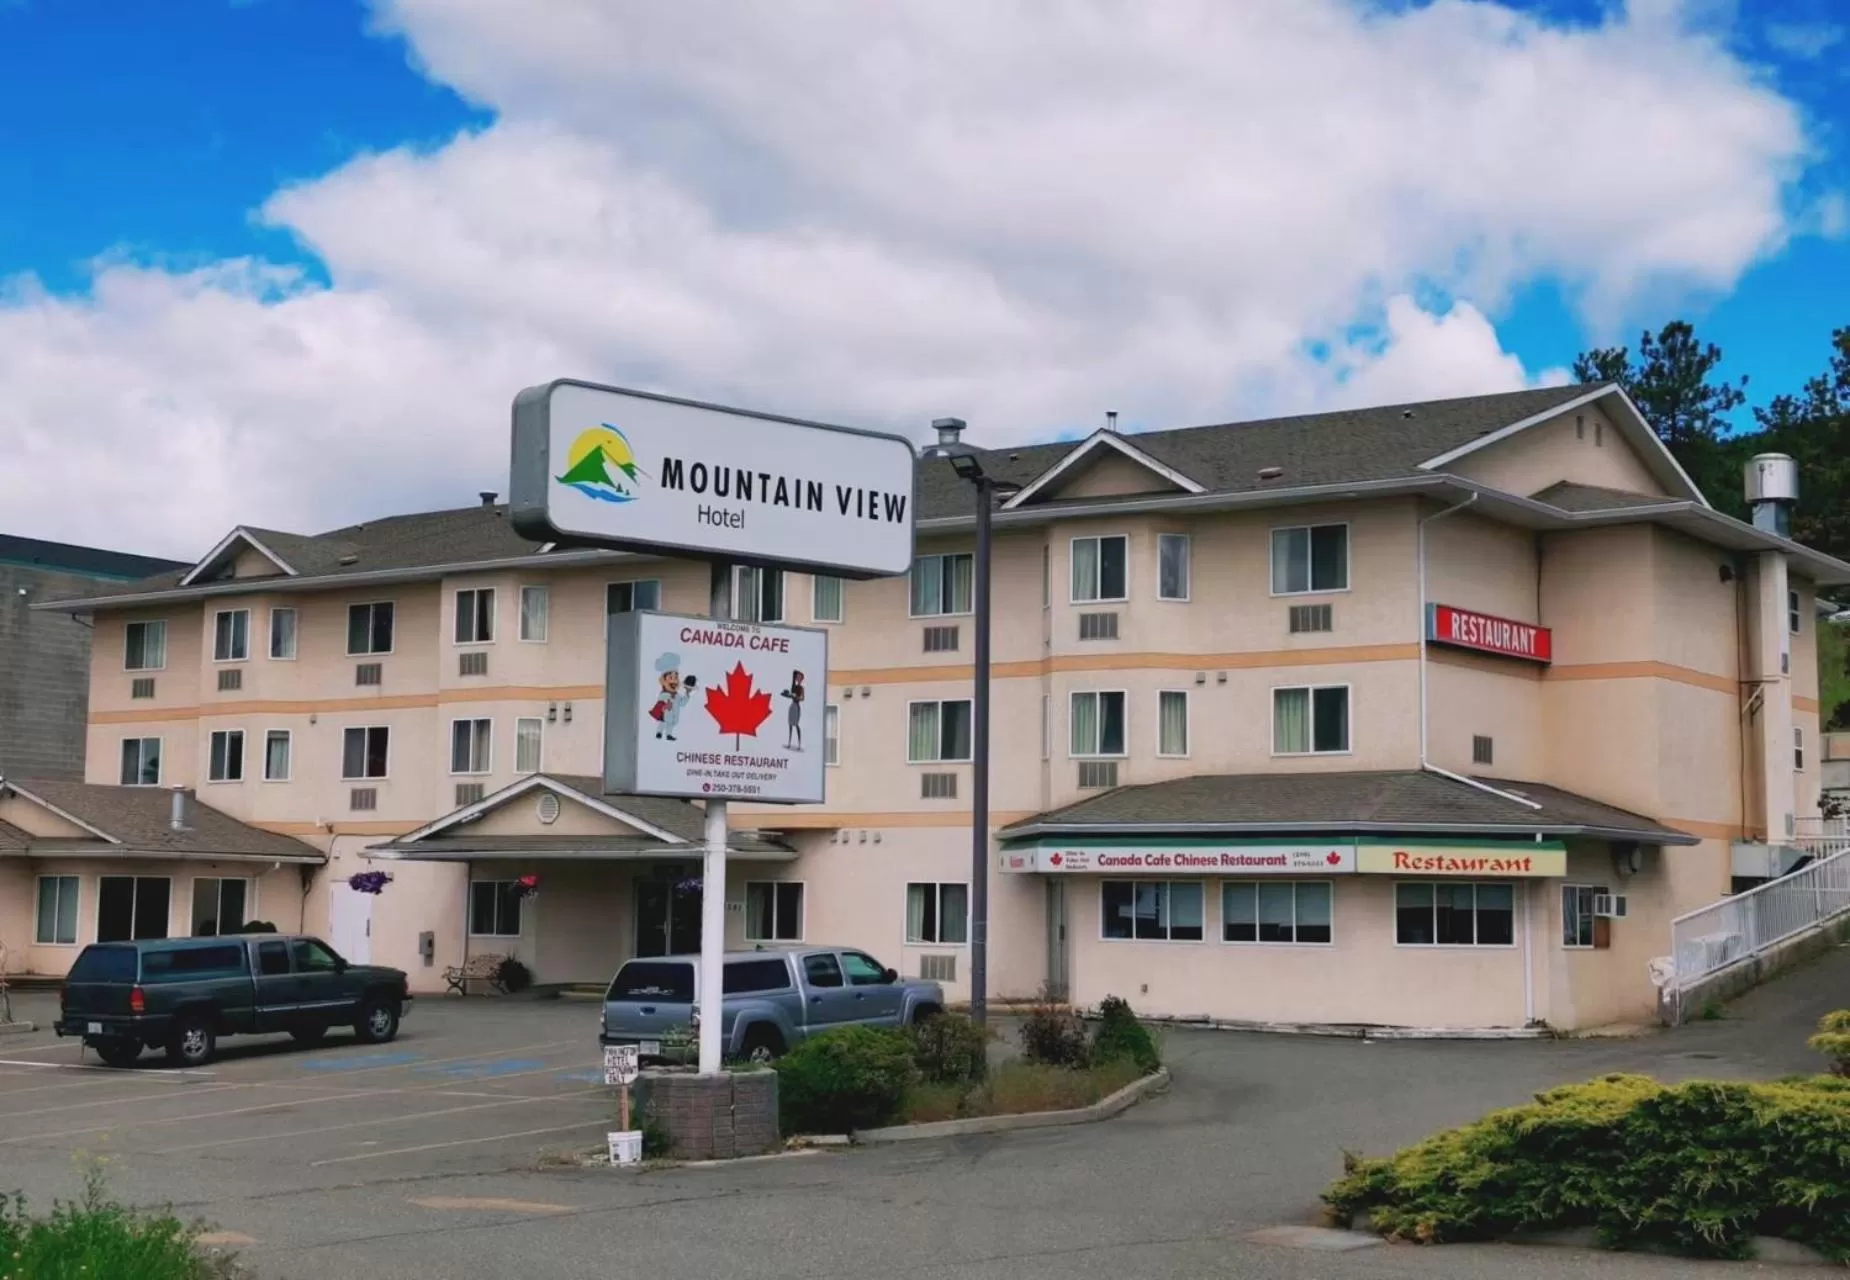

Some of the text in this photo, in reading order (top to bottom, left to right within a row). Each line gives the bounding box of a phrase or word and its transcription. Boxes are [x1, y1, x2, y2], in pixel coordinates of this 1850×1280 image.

[660, 457, 907, 524] MOUNTAIN VIEW
[697, 504, 746, 529] Hotel
[716, 622, 750, 633] WELCOME
[1451, 612, 1537, 654] RESTAURANT
[679, 627, 790, 653] CANADA CAFE
[676, 751, 789, 769] CHINESE RESTAURANT
[745, 772, 777, 781] DELIVERY
[1097, 853, 1143, 867] Canada
[1145, 853, 1171, 867] Cafe
[1173, 853, 1218, 867] Chinese
[1220, 853, 1287, 867] Restaurant
[1392, 851, 1533, 873] Restaurant
